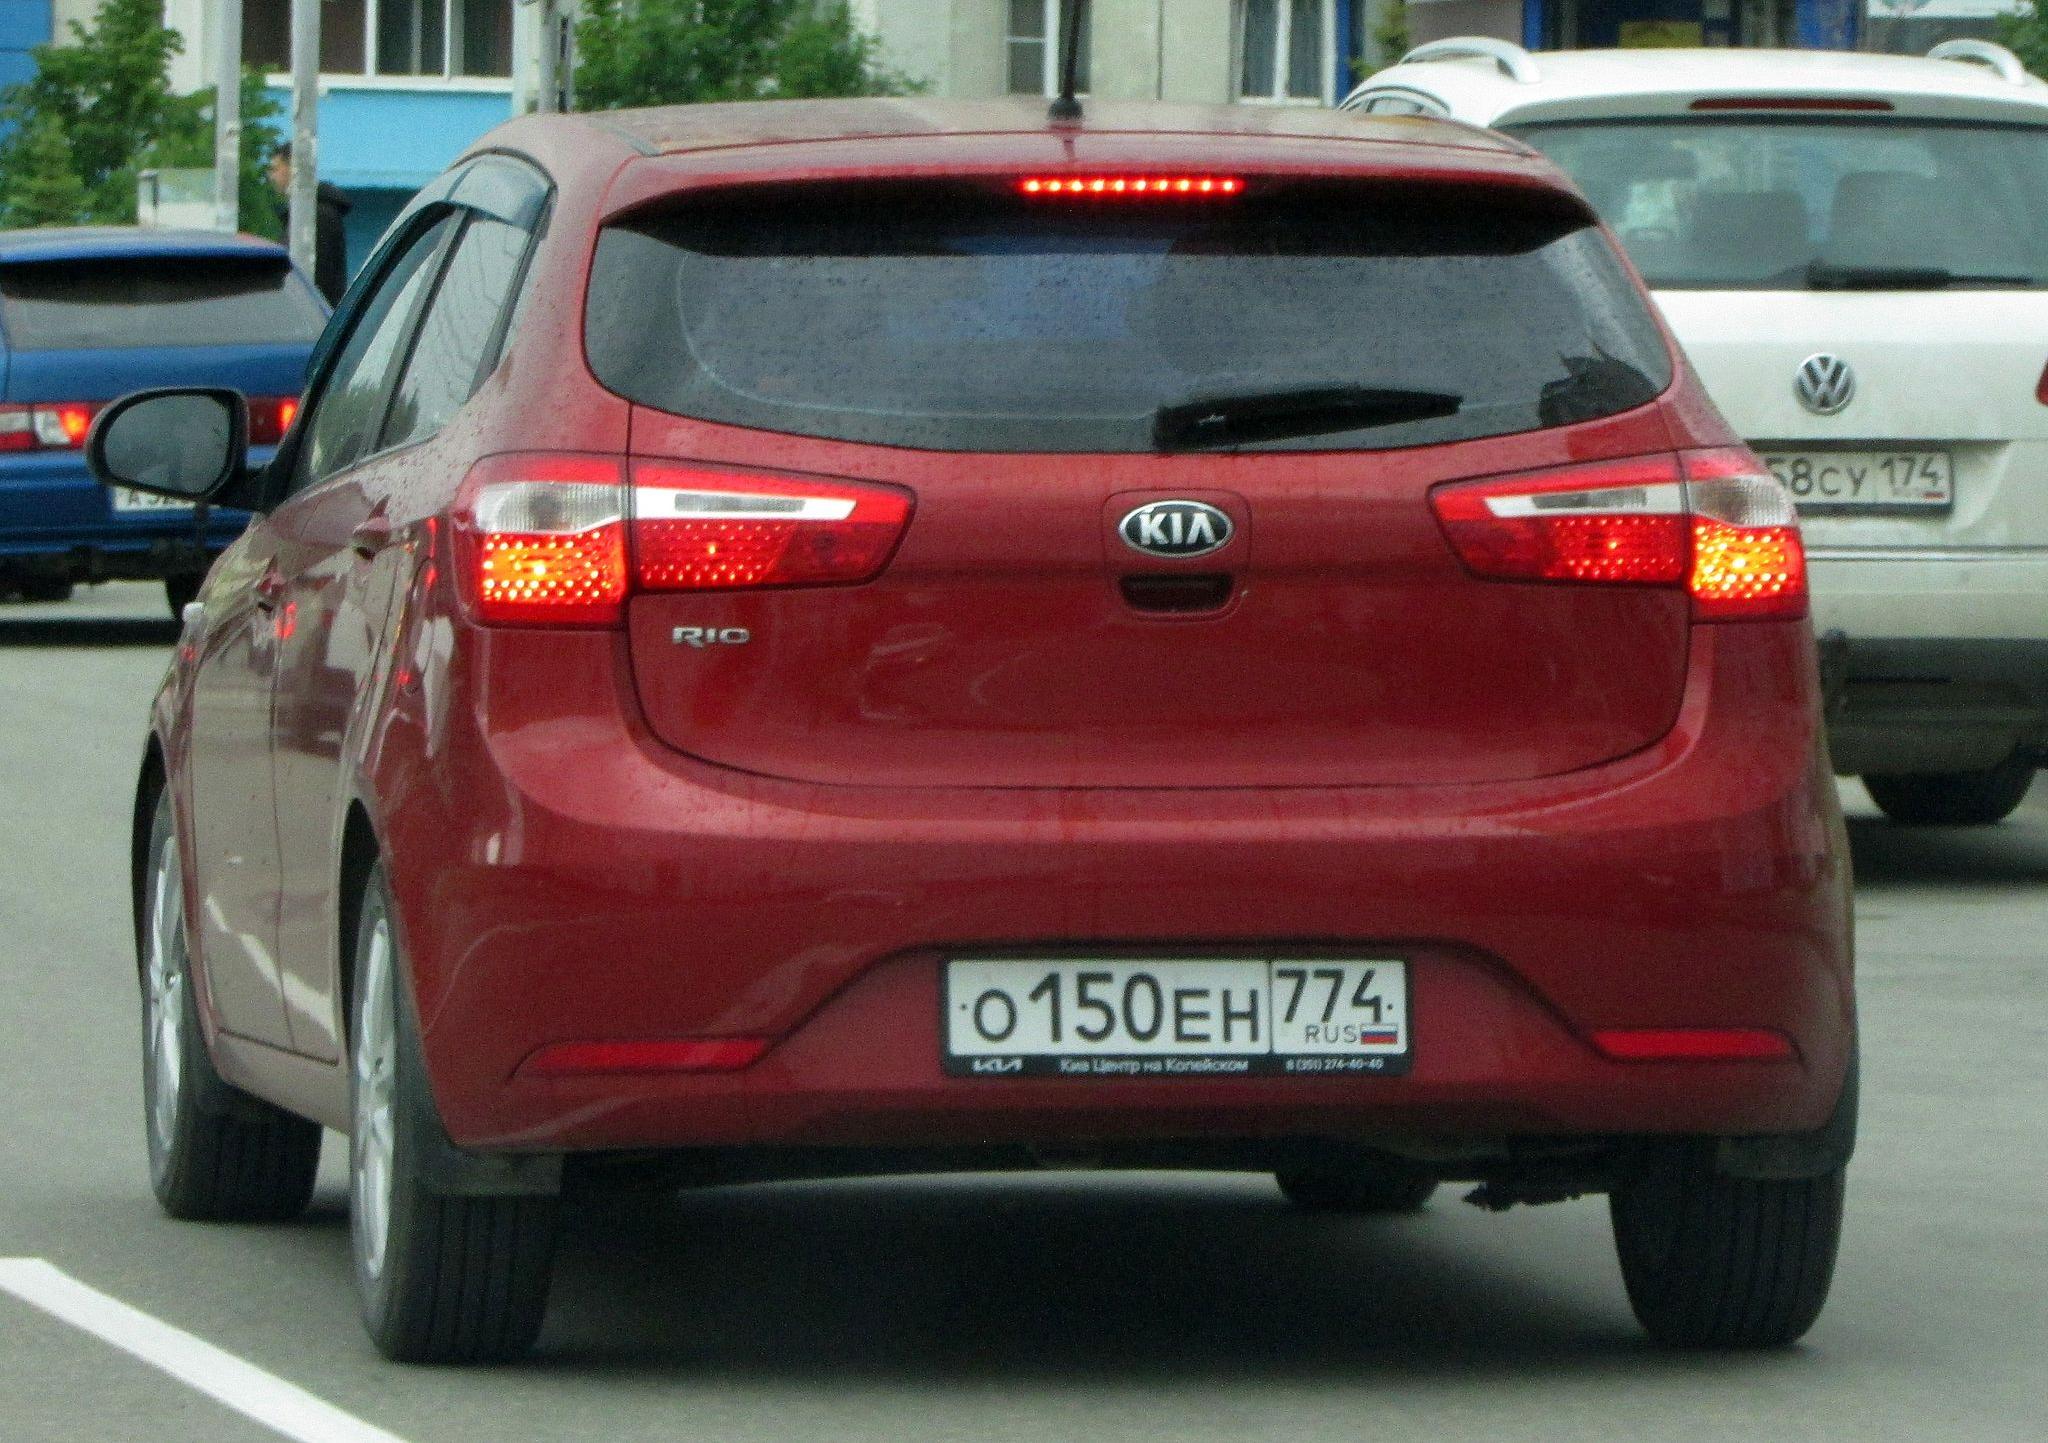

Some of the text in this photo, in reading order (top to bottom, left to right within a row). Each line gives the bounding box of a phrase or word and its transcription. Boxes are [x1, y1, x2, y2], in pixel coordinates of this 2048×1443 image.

[1880, 456, 1940, 487] 174
[1139, 512, 1216, 545] KIA
[672, 627, 750, 648] RIO
[1277, 968, 1382, 1023] 774
[1305, 1024, 1358, 1043] RUS
